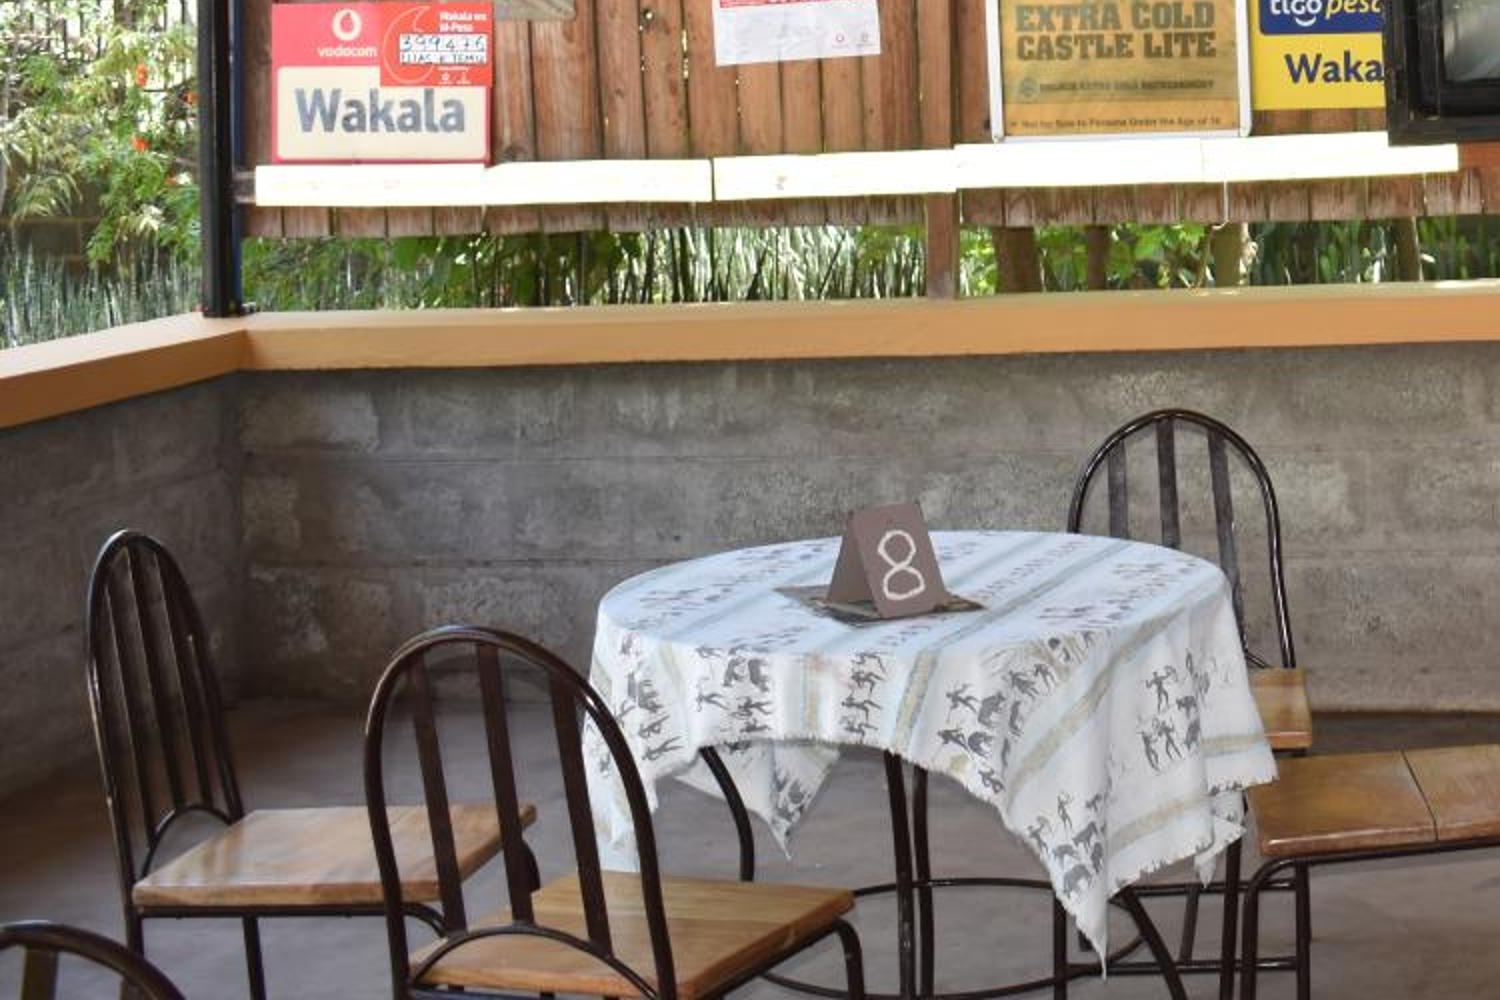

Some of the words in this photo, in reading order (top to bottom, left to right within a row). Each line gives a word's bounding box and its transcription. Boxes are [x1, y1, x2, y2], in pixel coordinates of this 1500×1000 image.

[1015, 1, 1123, 32] EXTRA
[1131, 0, 1217, 30] COLD
[317, 45, 378, 58] vodacom
[1016, 33, 1135, 61] CASTLE
[1143, 31, 1218, 59] LITE
[294, 87, 466, 133] Wakala
[876, 529, 927, 601] 8
